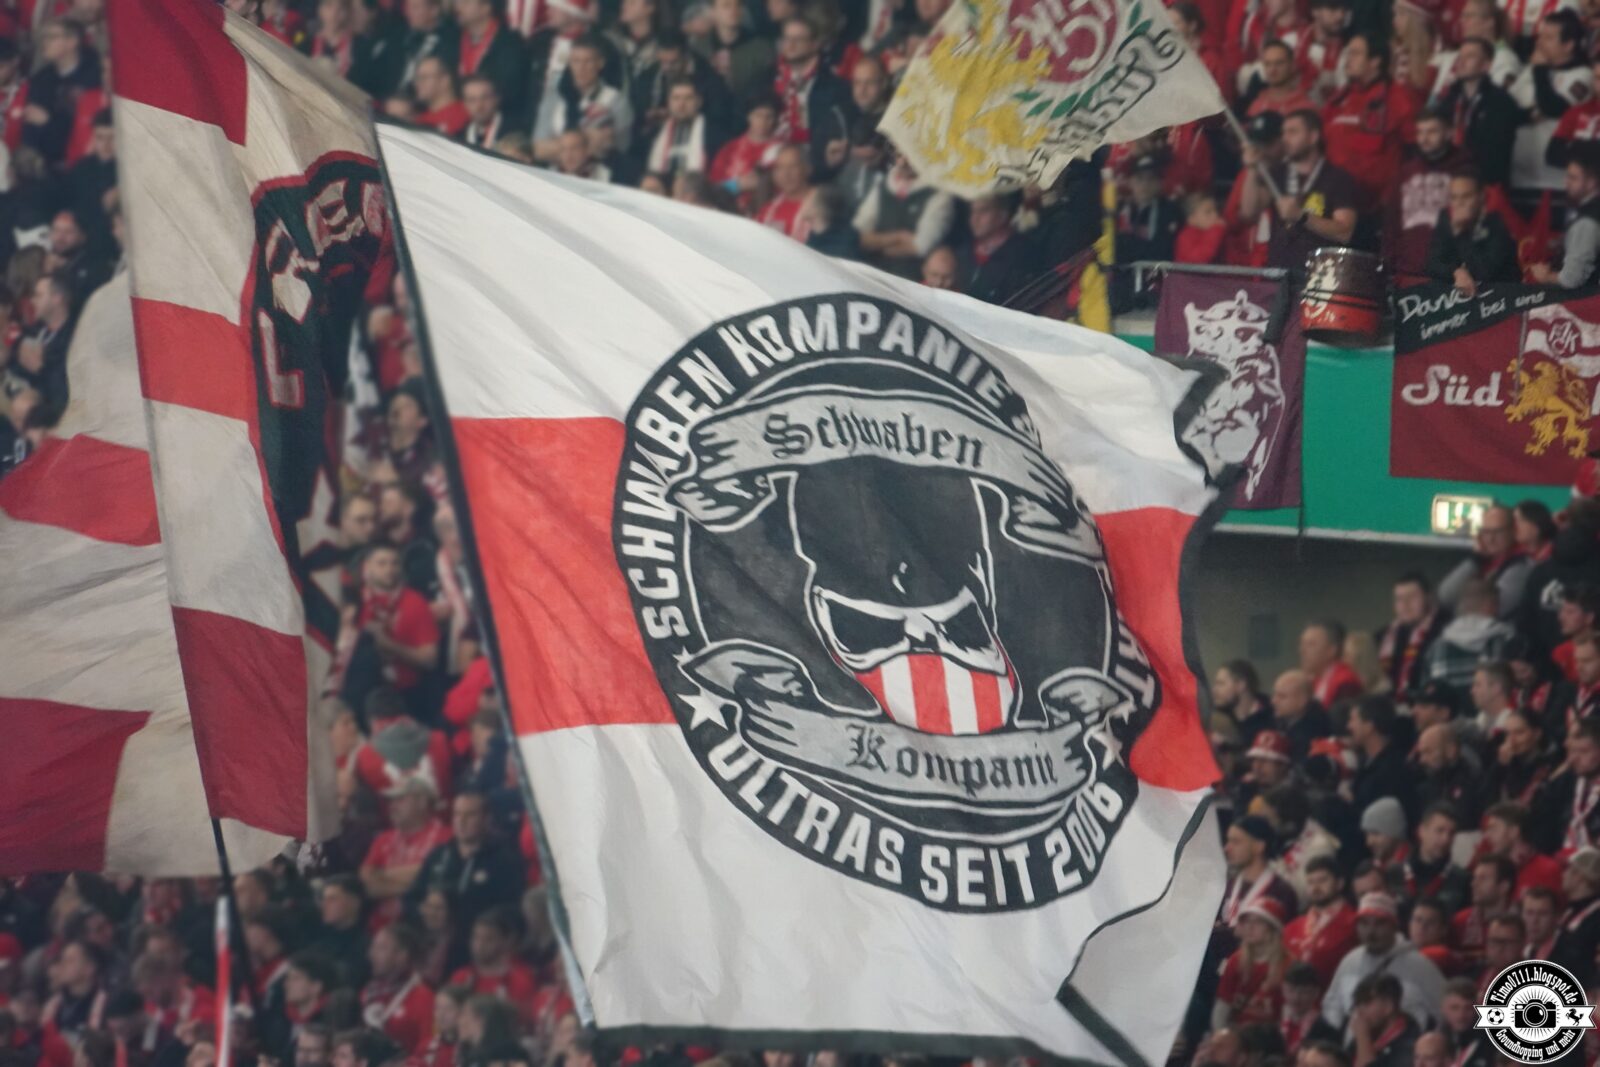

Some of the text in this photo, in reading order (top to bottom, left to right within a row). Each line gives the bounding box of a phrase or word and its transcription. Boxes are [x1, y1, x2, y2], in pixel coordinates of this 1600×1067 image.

[763, 404, 986, 469] Schwaben
[1401, 363, 1504, 407] Süd
[621, 300, 1013, 640] SCHWABEN KOMPANIE
[708, 741, 1124, 907] ULTRAS SEIT 2006
